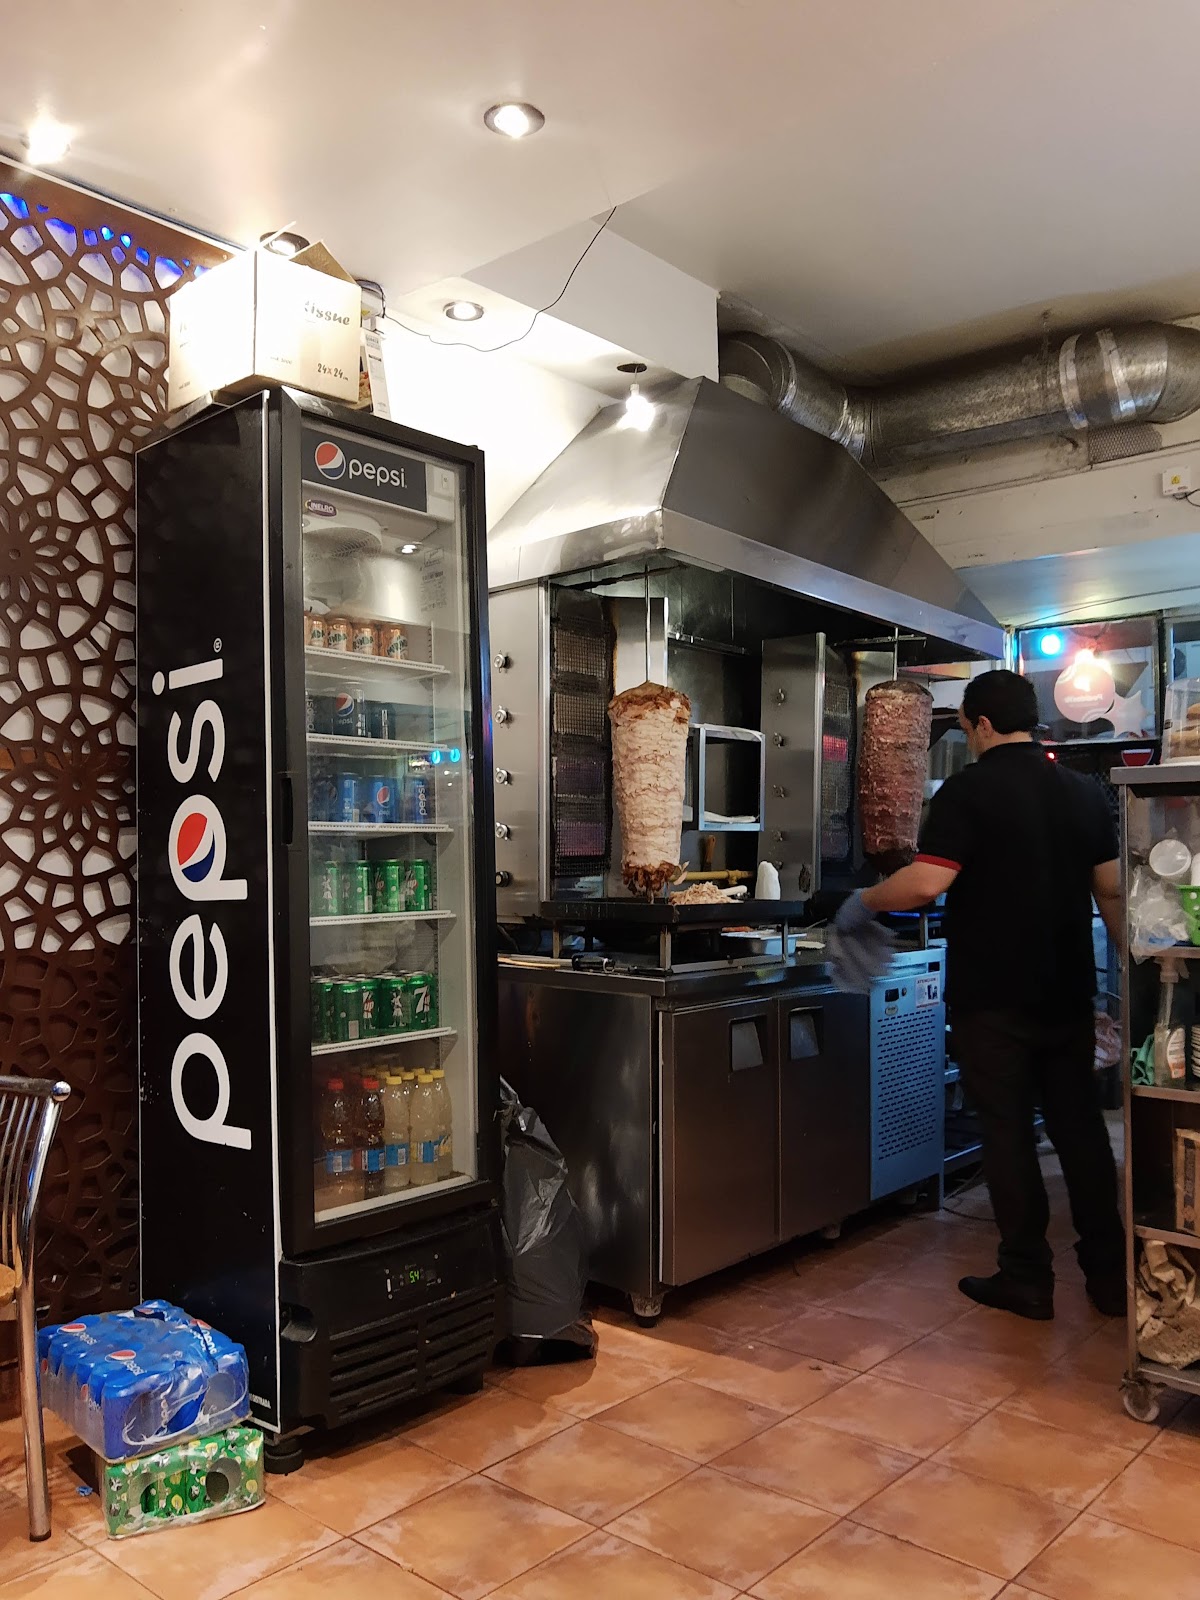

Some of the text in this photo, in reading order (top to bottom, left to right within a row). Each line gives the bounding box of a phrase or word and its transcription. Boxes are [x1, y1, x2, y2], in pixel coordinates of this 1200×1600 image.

[348, 458, 405, 488] pepsi
[416, 783, 428, 816] pepsi
[152, 658, 252, 1151] pepsi
